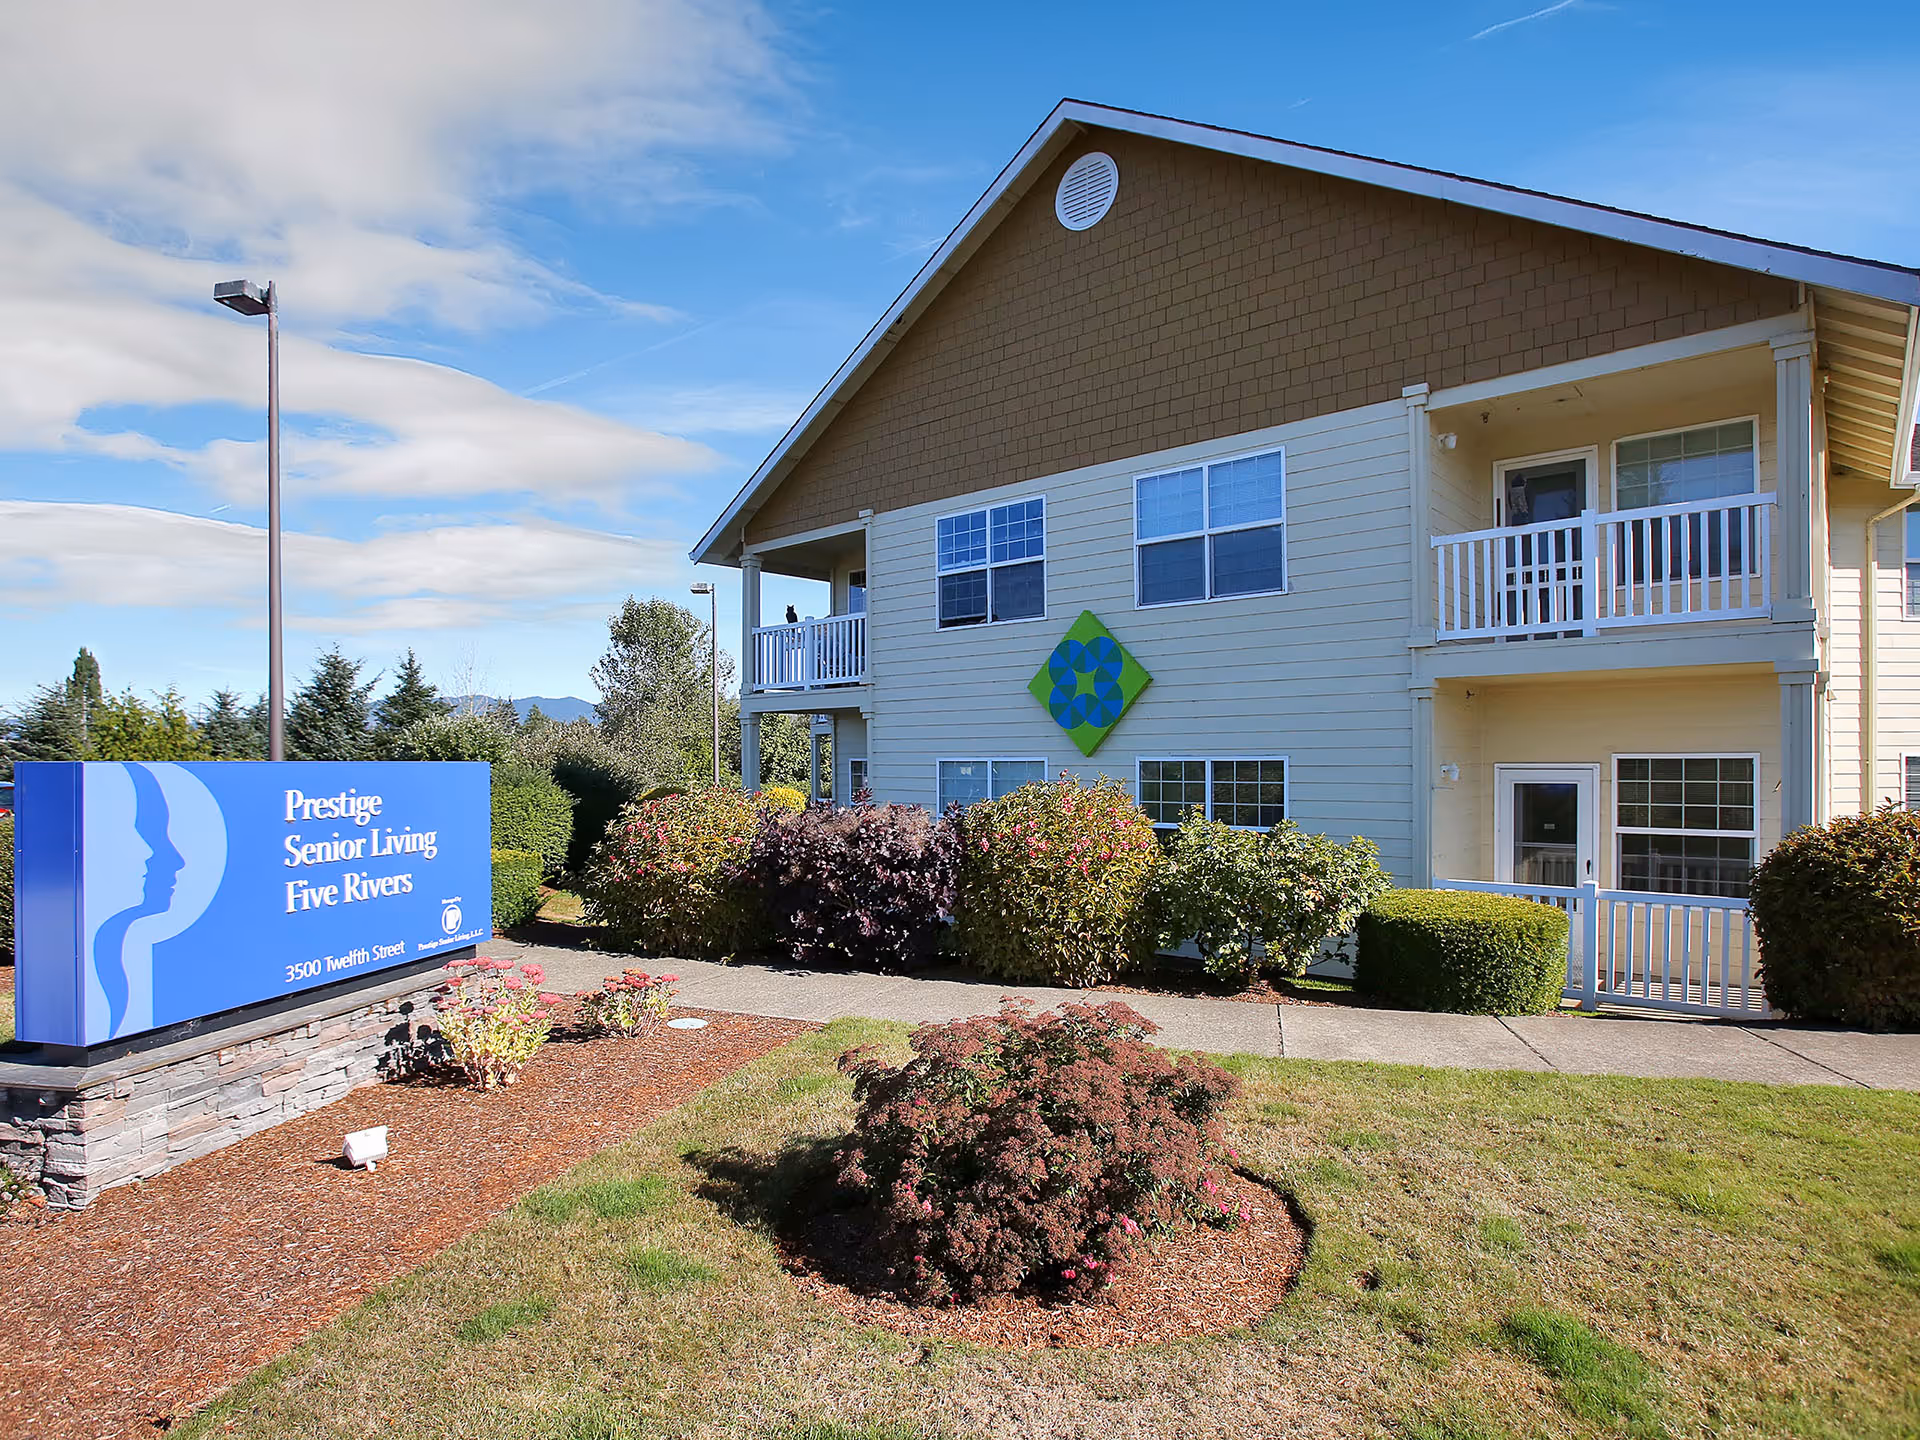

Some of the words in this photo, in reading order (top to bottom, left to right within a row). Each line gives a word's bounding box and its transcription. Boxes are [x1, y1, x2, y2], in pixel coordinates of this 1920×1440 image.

[284, 788, 383, 826] Prestige
[284, 832, 367, 867] Senior
[370, 826, 438, 860] Living
[285, 879, 339, 913] Five
[343, 872, 413, 903] Rivers
[284, 959, 322, 983] 3500
[324, 947, 370, 973] Twelfth
[371, 940, 406, 961] Street
